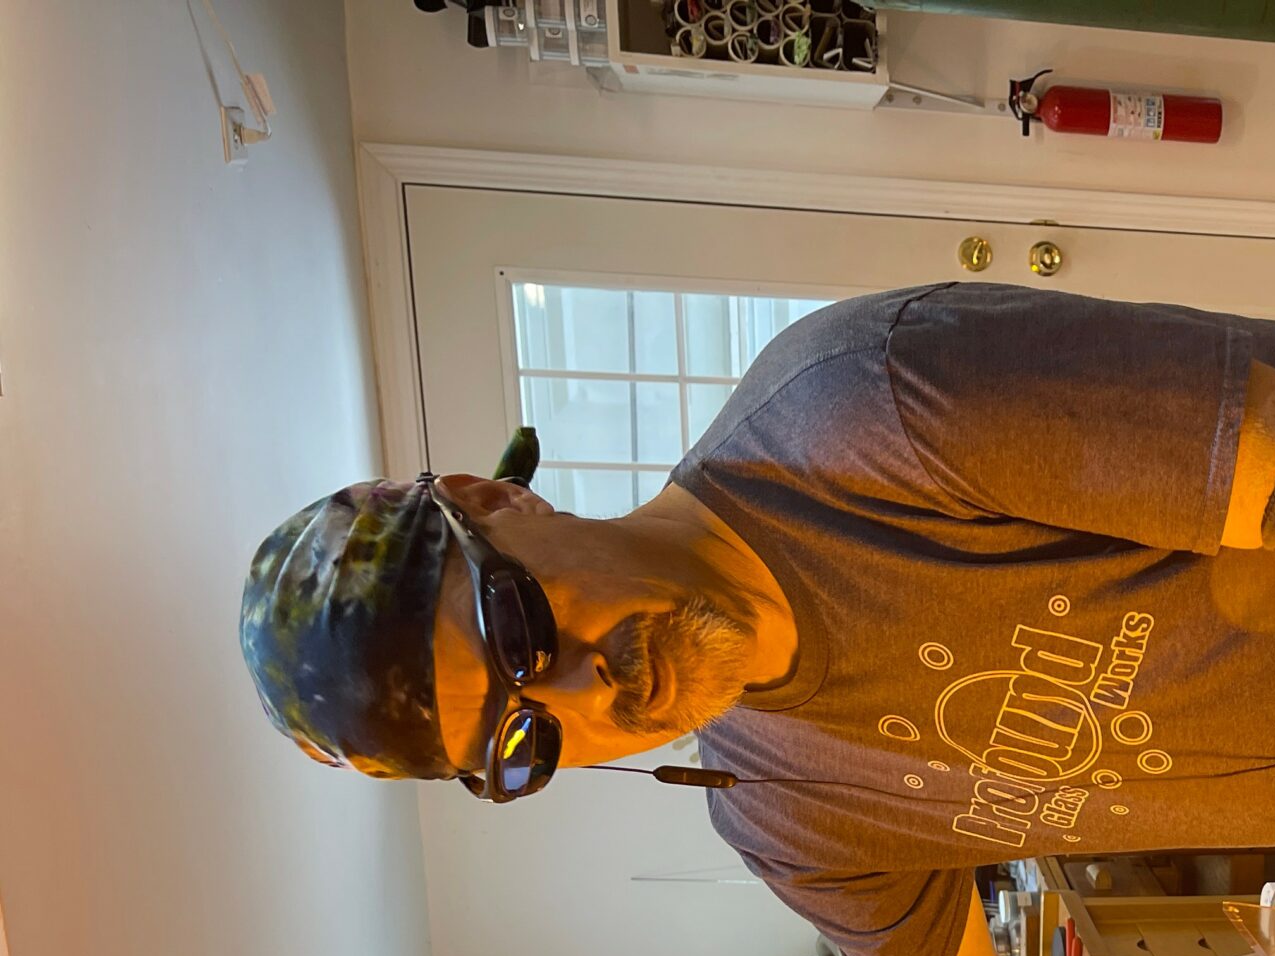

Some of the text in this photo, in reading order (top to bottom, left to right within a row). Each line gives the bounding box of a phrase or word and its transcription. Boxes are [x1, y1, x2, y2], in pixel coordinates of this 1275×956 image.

[1090, 611, 1154, 709] Works
[953, 624, 1103, 847] Profound
[1040, 786, 1089, 828] Glass
